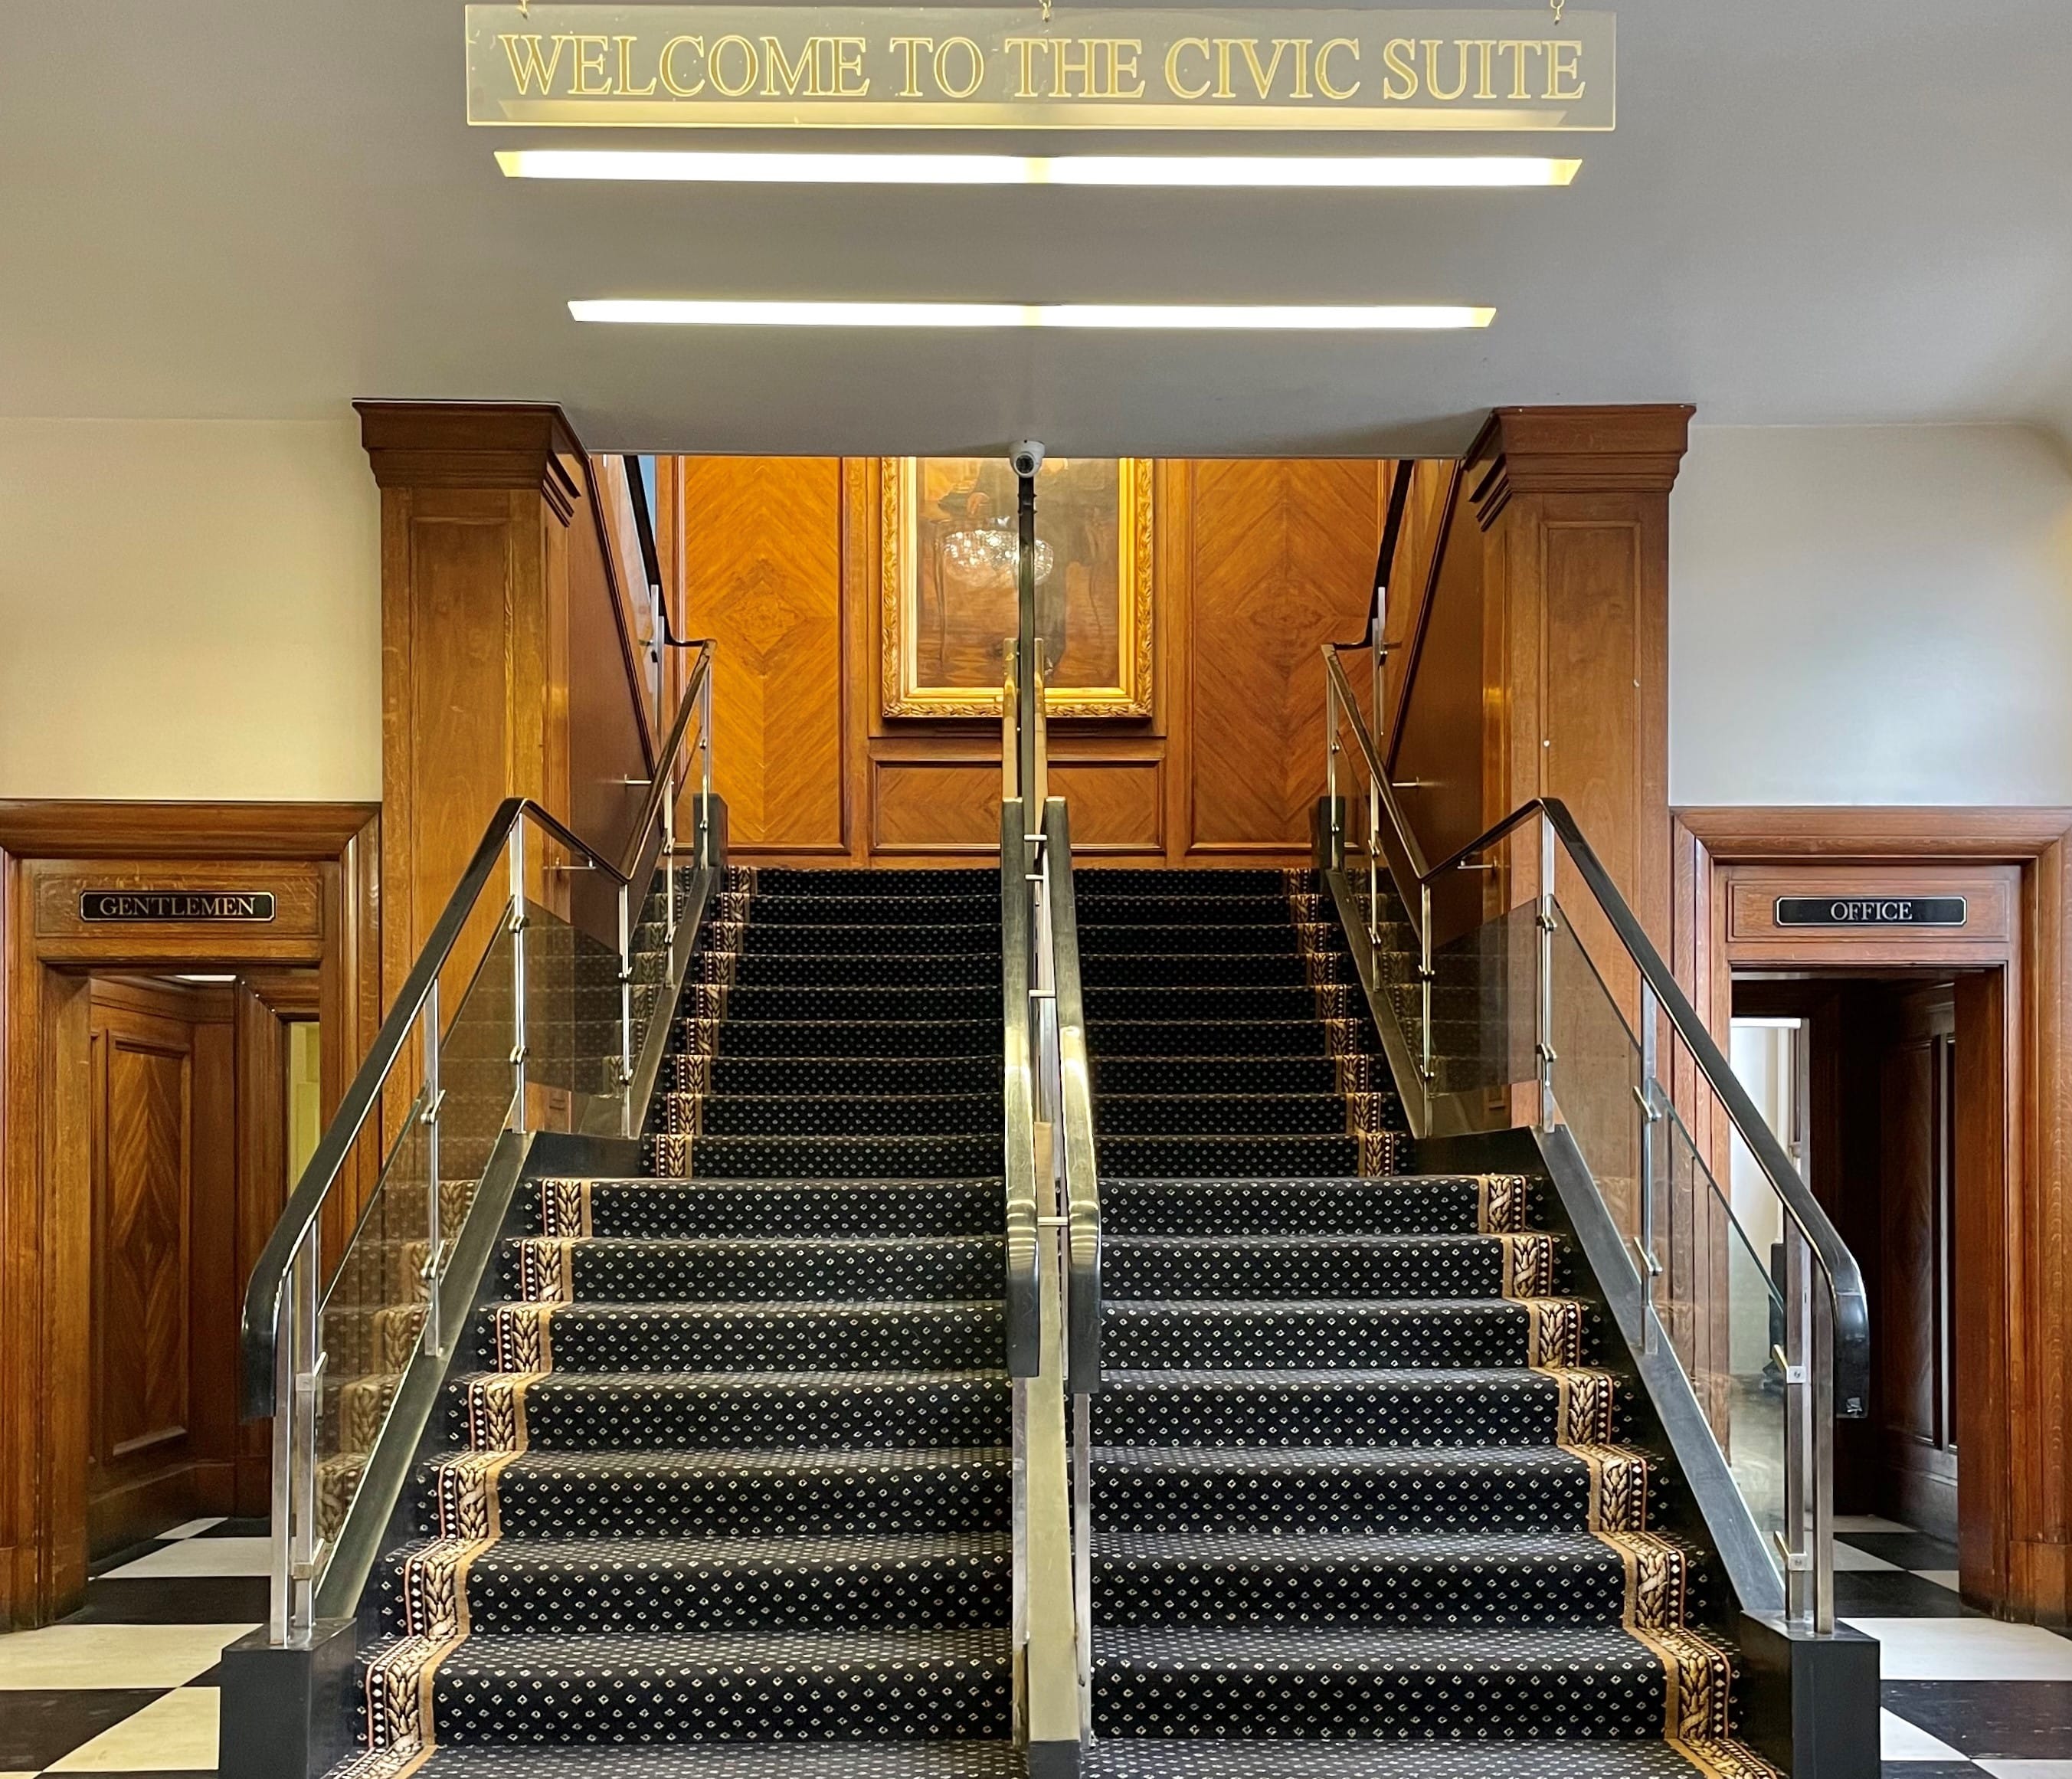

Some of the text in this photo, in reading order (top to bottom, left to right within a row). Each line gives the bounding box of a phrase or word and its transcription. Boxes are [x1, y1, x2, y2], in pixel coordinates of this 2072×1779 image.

[498, 34, 1586, 101] WELCOME TO THE CIVIC SUITE
[99, 896, 256, 916] GENTLEMEN
[1830, 901, 1913, 920] OFFICE
